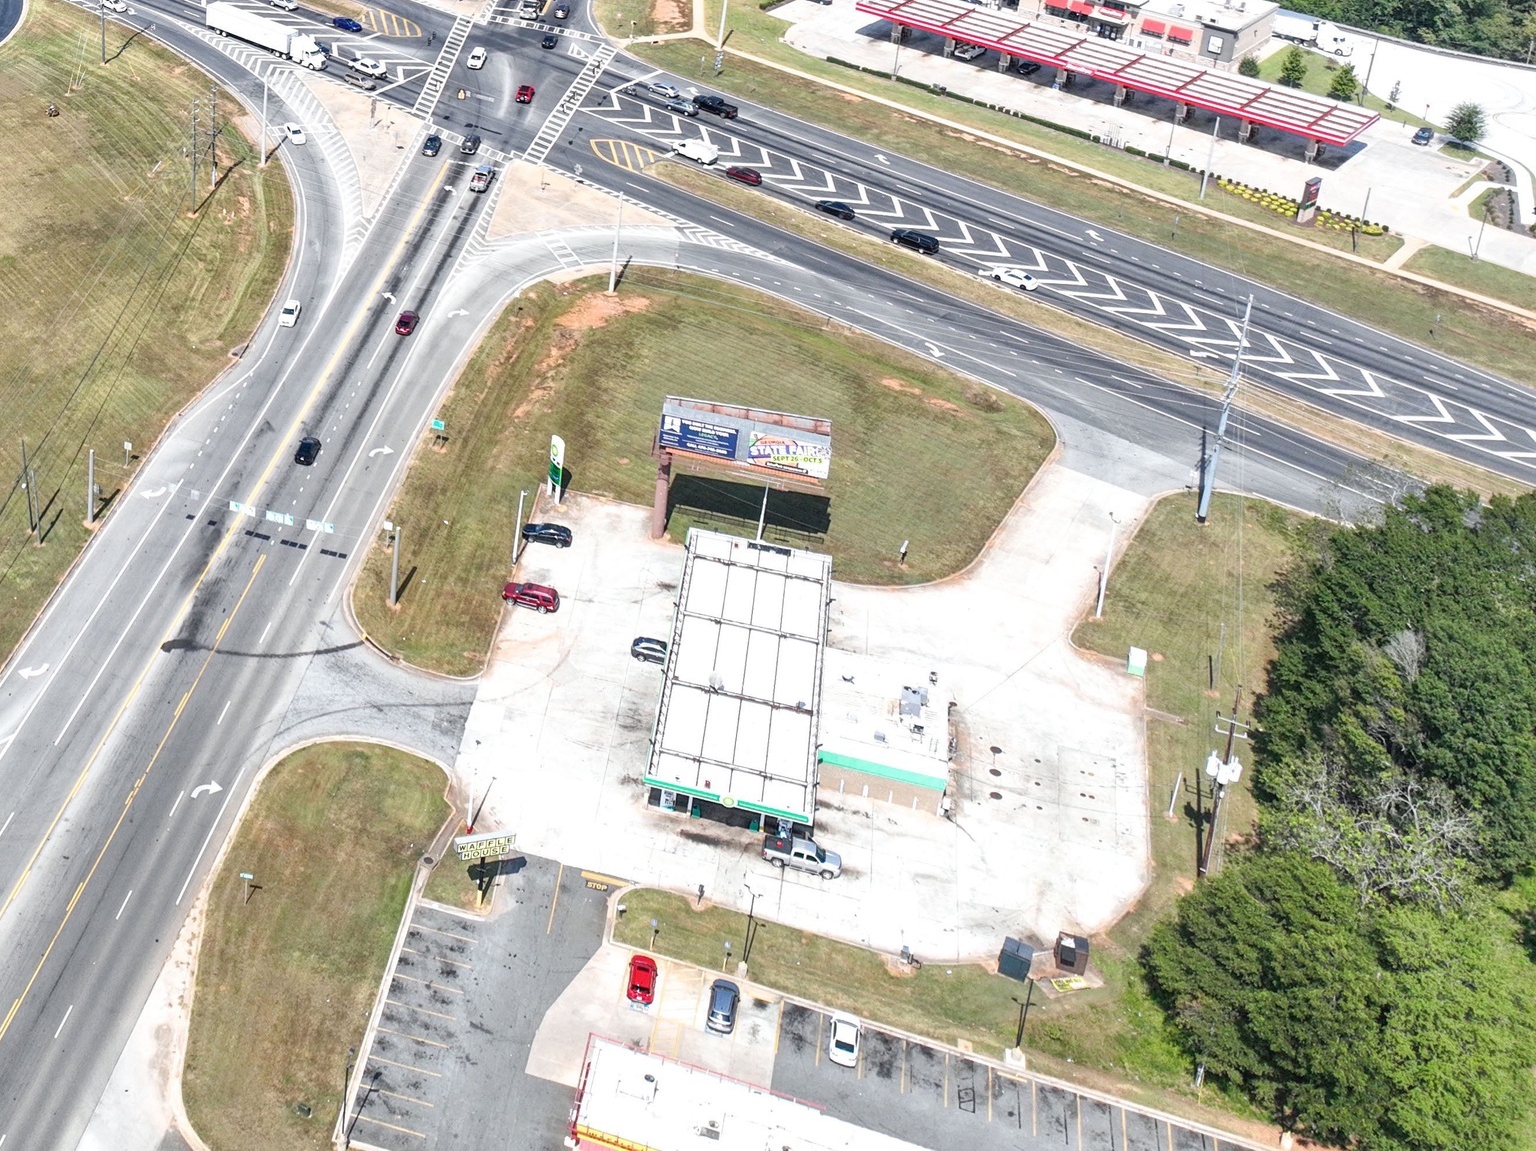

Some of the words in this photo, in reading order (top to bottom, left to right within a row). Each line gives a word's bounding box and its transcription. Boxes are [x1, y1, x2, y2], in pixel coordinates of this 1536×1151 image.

[749, 445, 786, 456] STATE
[459, 837, 513, 851] WAFFLE
[463, 846, 507, 858] HOUSE
[587, 881, 609, 891] STOP
